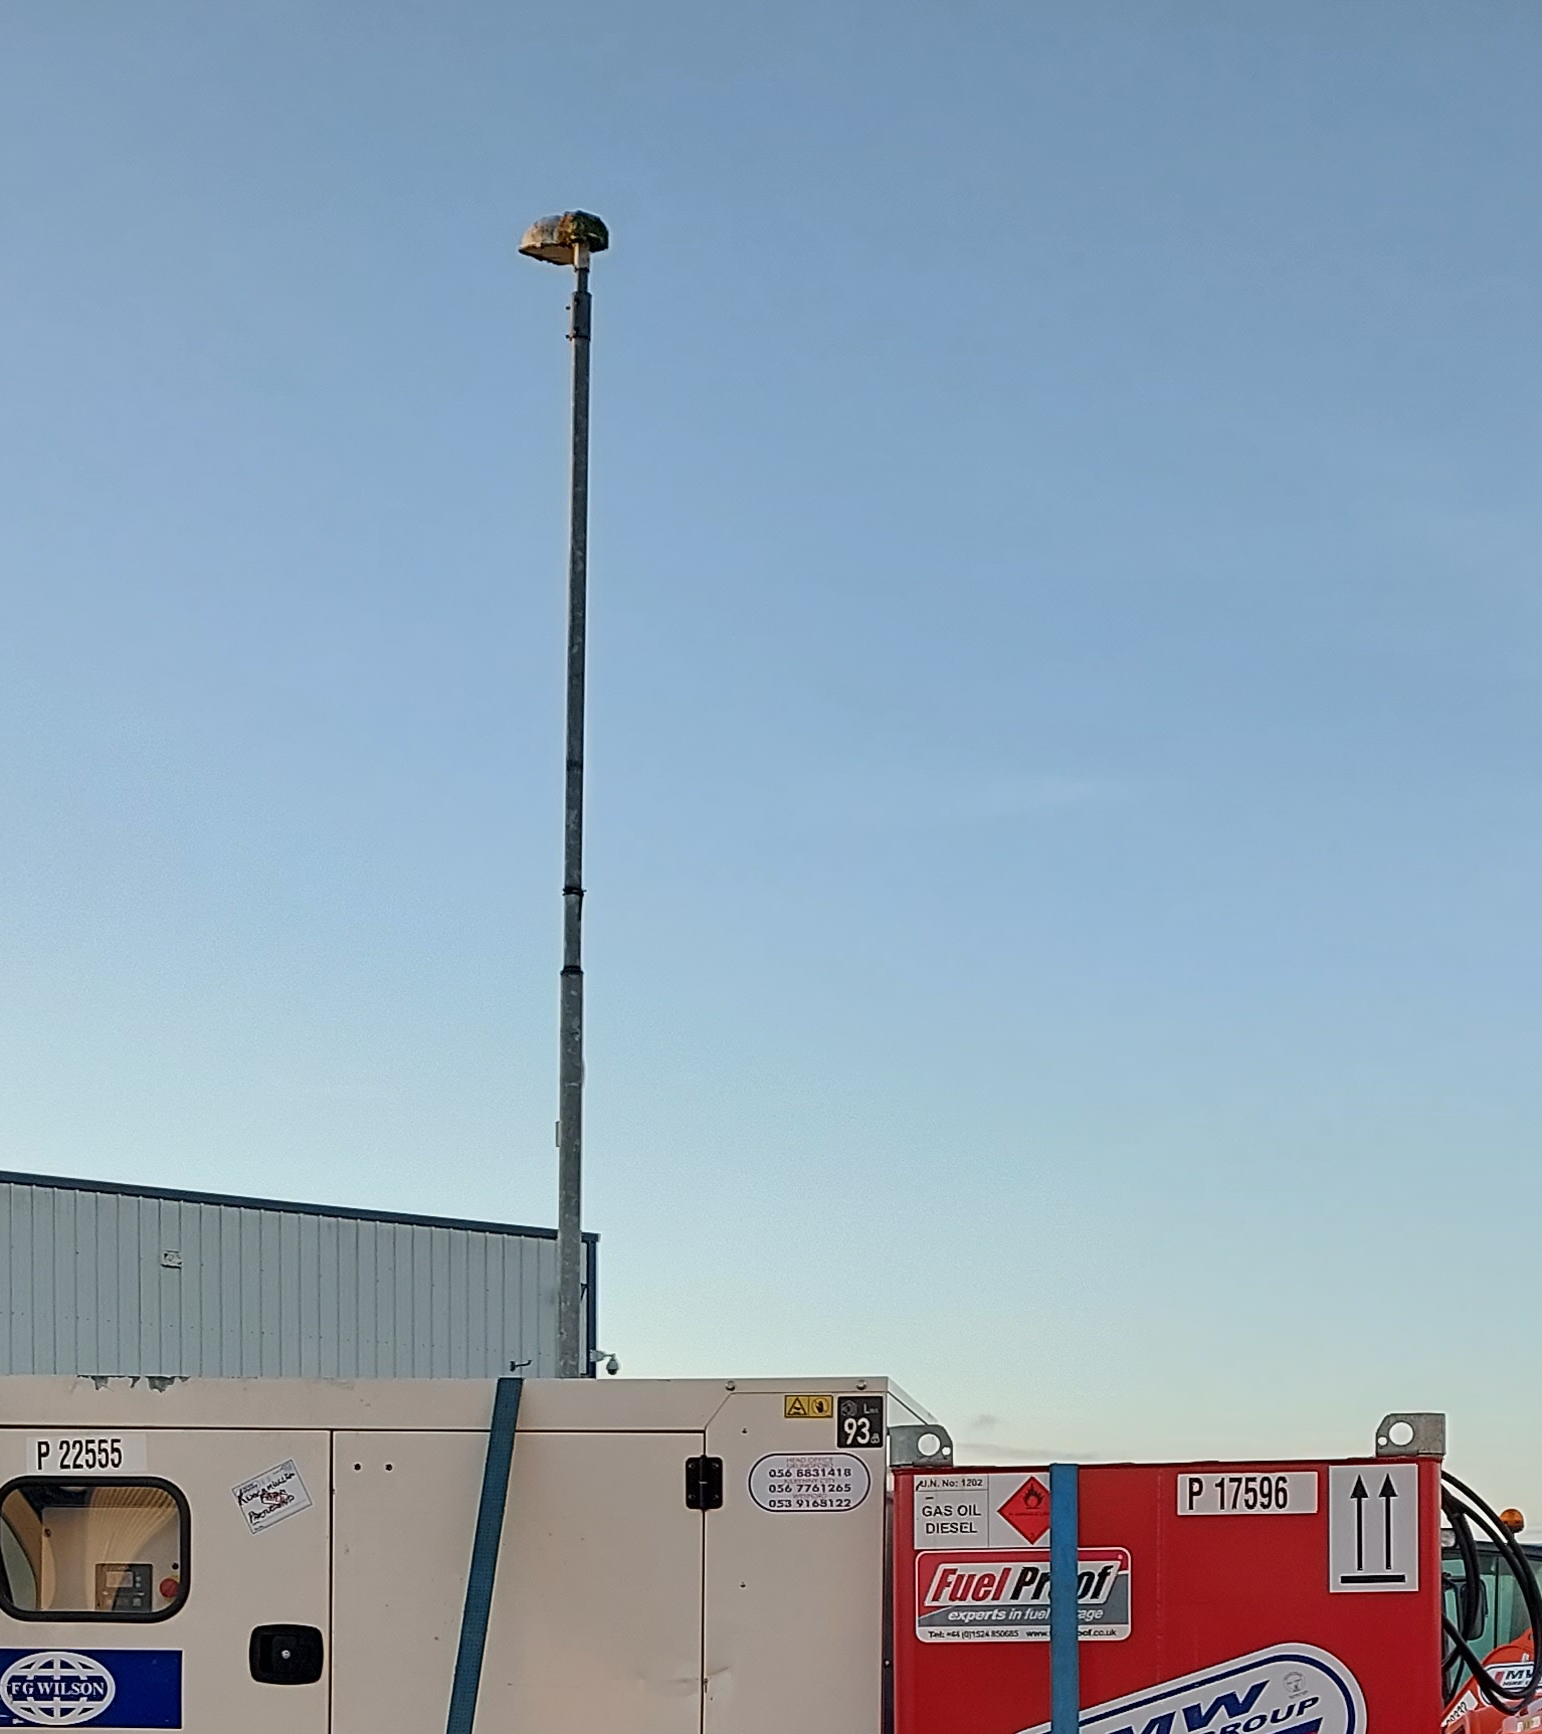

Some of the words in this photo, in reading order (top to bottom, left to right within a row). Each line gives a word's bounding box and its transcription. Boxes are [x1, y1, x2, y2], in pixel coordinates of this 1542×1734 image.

[844, 1417, 870, 1445] 93
[37, 1440, 50, 1470] P
[59, 1438, 122, 1469] 22555
[768, 1469, 793, 1478] 056
[768, 1484, 793, 1493] 056
[796, 1484, 852, 1493] 7761265
[961, 1479, 983, 1487] 1202
[1188, 1477, 1203, 1510] P
[1215, 1476, 1288, 1510] 17596
[922, 1505, 953, 1517] GAS
[957, 1504, 981, 1516] OIL
[925, 1522, 978, 1534] DIESEL
[932, 1567, 1012, 1602] Fuel
[1010, 1565, 1114, 1601] Prof
[948, 1609, 1006, 1622] experts
[1009, 1608, 1022, 1620] in
[1023, 1607, 1050, 1620] fuel
[37, 1682, 105, 1695] WILSON
